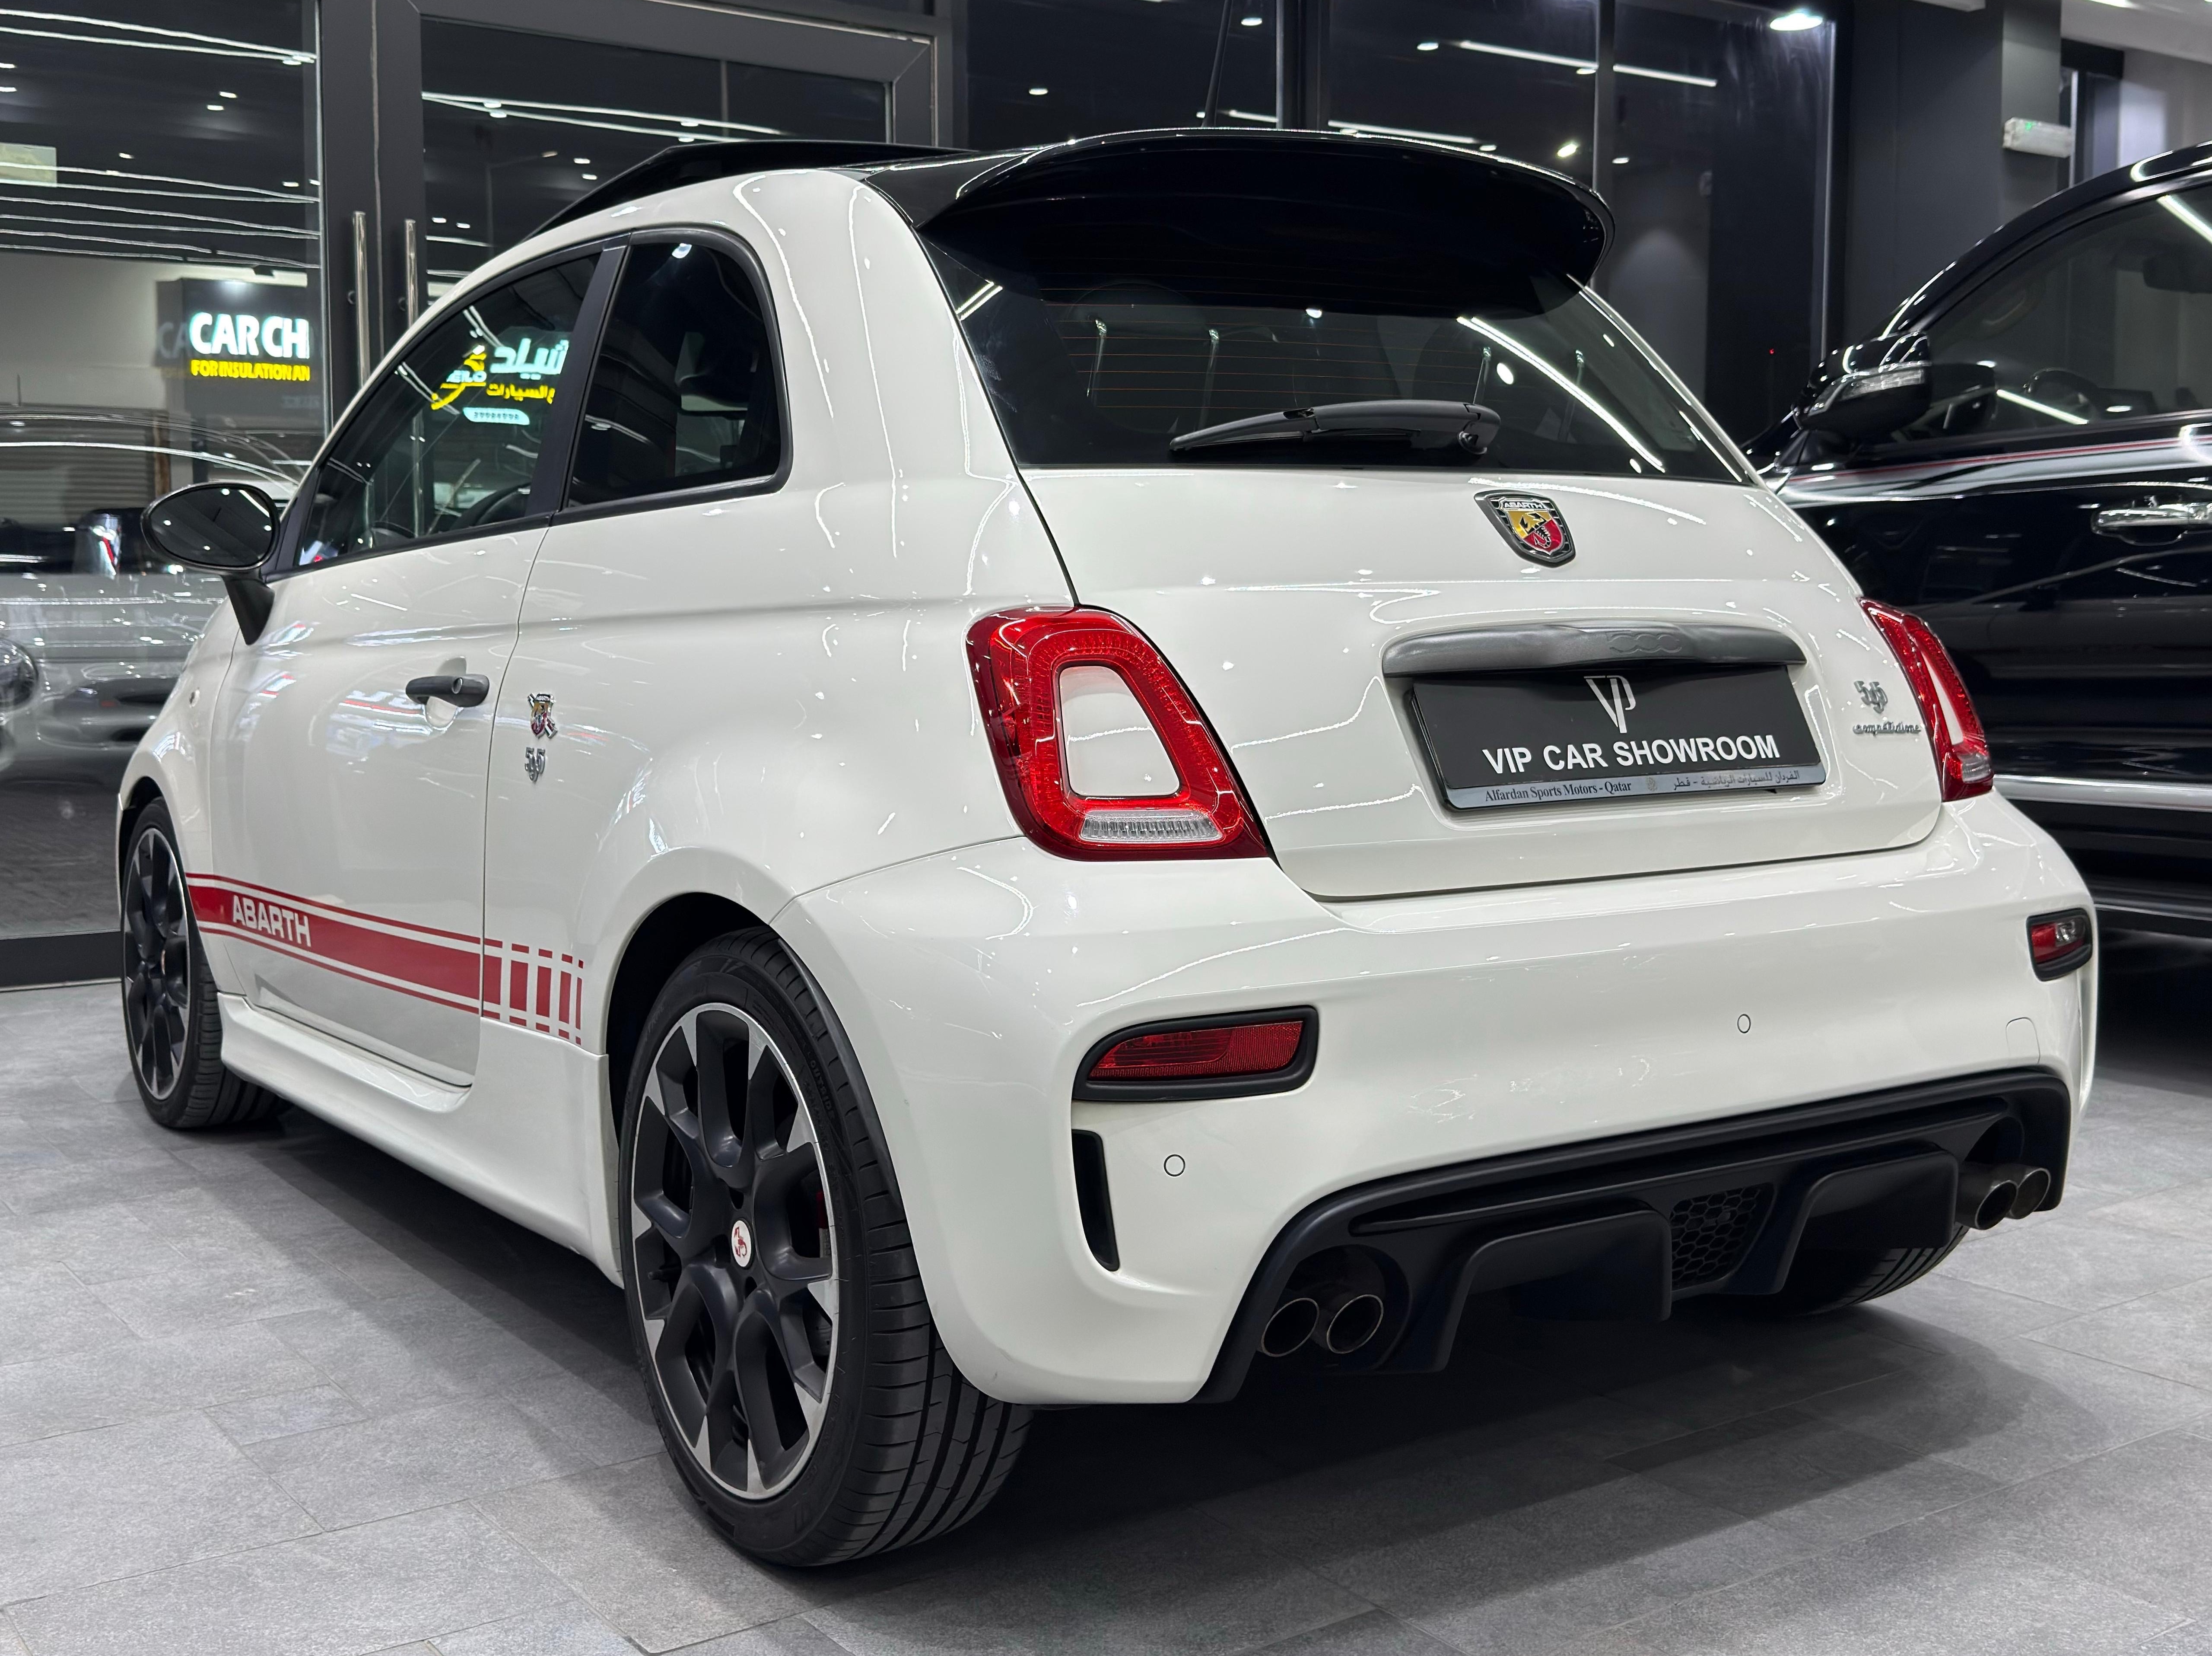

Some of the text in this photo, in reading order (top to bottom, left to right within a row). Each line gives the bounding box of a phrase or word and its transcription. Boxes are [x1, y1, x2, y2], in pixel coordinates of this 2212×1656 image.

[189, 312, 259, 356] CAR
[191, 359, 218, 377] FOR
[218, 361, 292, 380] INSULATION
[1482, 735, 1780, 774] VIP CAR SHOWROOM
[1673, 777, 1691, 790] قطر
[1738, 772, 1773, 785] للسيارات
[1775, 770, 1800, 784] الفردان
[1485, 788, 1529, 801] Alfardan
[1530, 786, 1562, 800] Sports
[1563, 784, 1597, 795] Motors
[1604, 781, 1632, 794] Qatar
[232, 895, 311, 947] ABARTH
